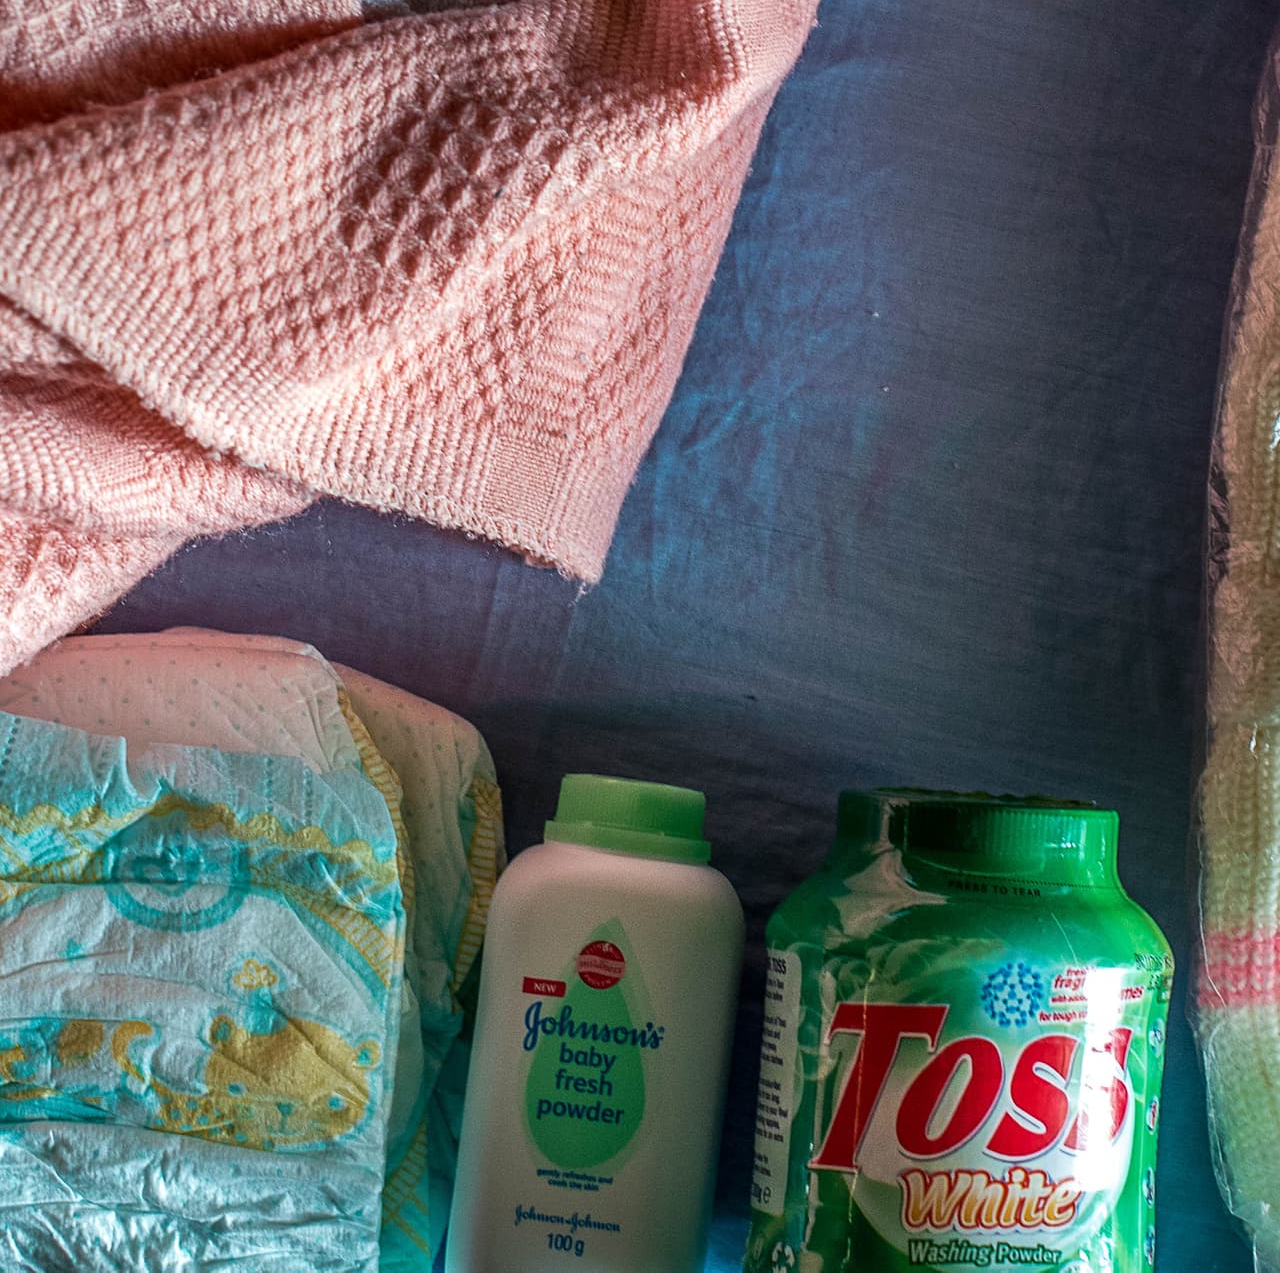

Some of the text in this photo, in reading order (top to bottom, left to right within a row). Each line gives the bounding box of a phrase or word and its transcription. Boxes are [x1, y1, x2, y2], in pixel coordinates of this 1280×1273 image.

[991, 885, 1009, 896] TO
[1013, 887, 1042, 898] TEAR
[532, 981, 558, 994] NEW
[1038, 1011, 1051, 1023] for
[1053, 1011, 1076, 1024] tough
[559, 1042, 617, 1075] baby
[555, 1069, 613, 1096] fresh
[536, 1098, 625, 1124] powder
[598, 1176, 614, 1184] and
[900, 1167, 1082, 1230] White
[547, 1233, 573, 1251] 100
[909, 1240, 1062, 1267] Washing Powder
